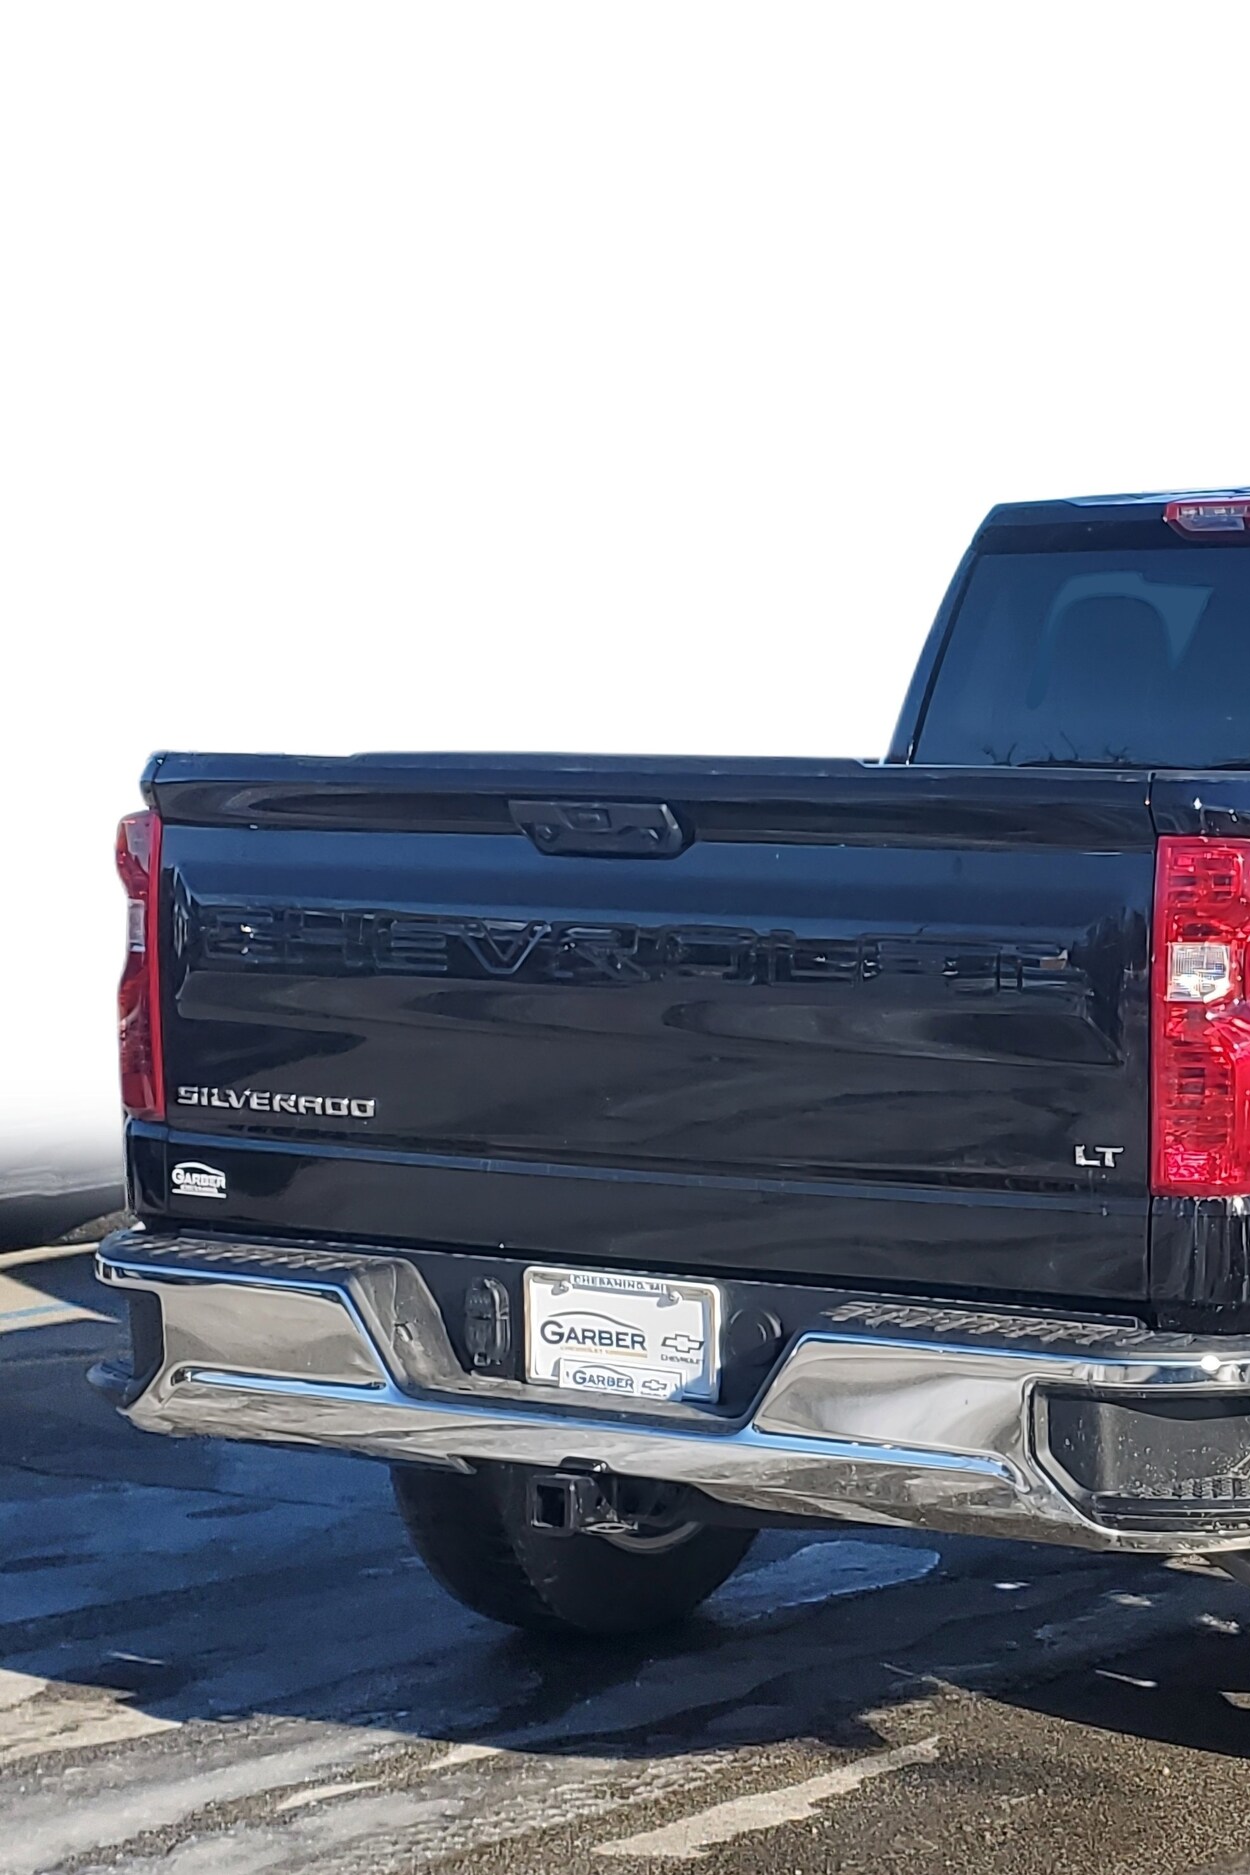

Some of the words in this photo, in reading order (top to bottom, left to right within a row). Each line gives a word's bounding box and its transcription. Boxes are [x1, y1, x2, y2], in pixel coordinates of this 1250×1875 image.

[177, 1086, 376, 1118] SILVERADO
[1074, 1144, 1124, 1168] LT
[171, 1168, 227, 1190] GARBER
[540, 1320, 647, 1351] GARBER
[572, 1369, 635, 1391] GARBER
